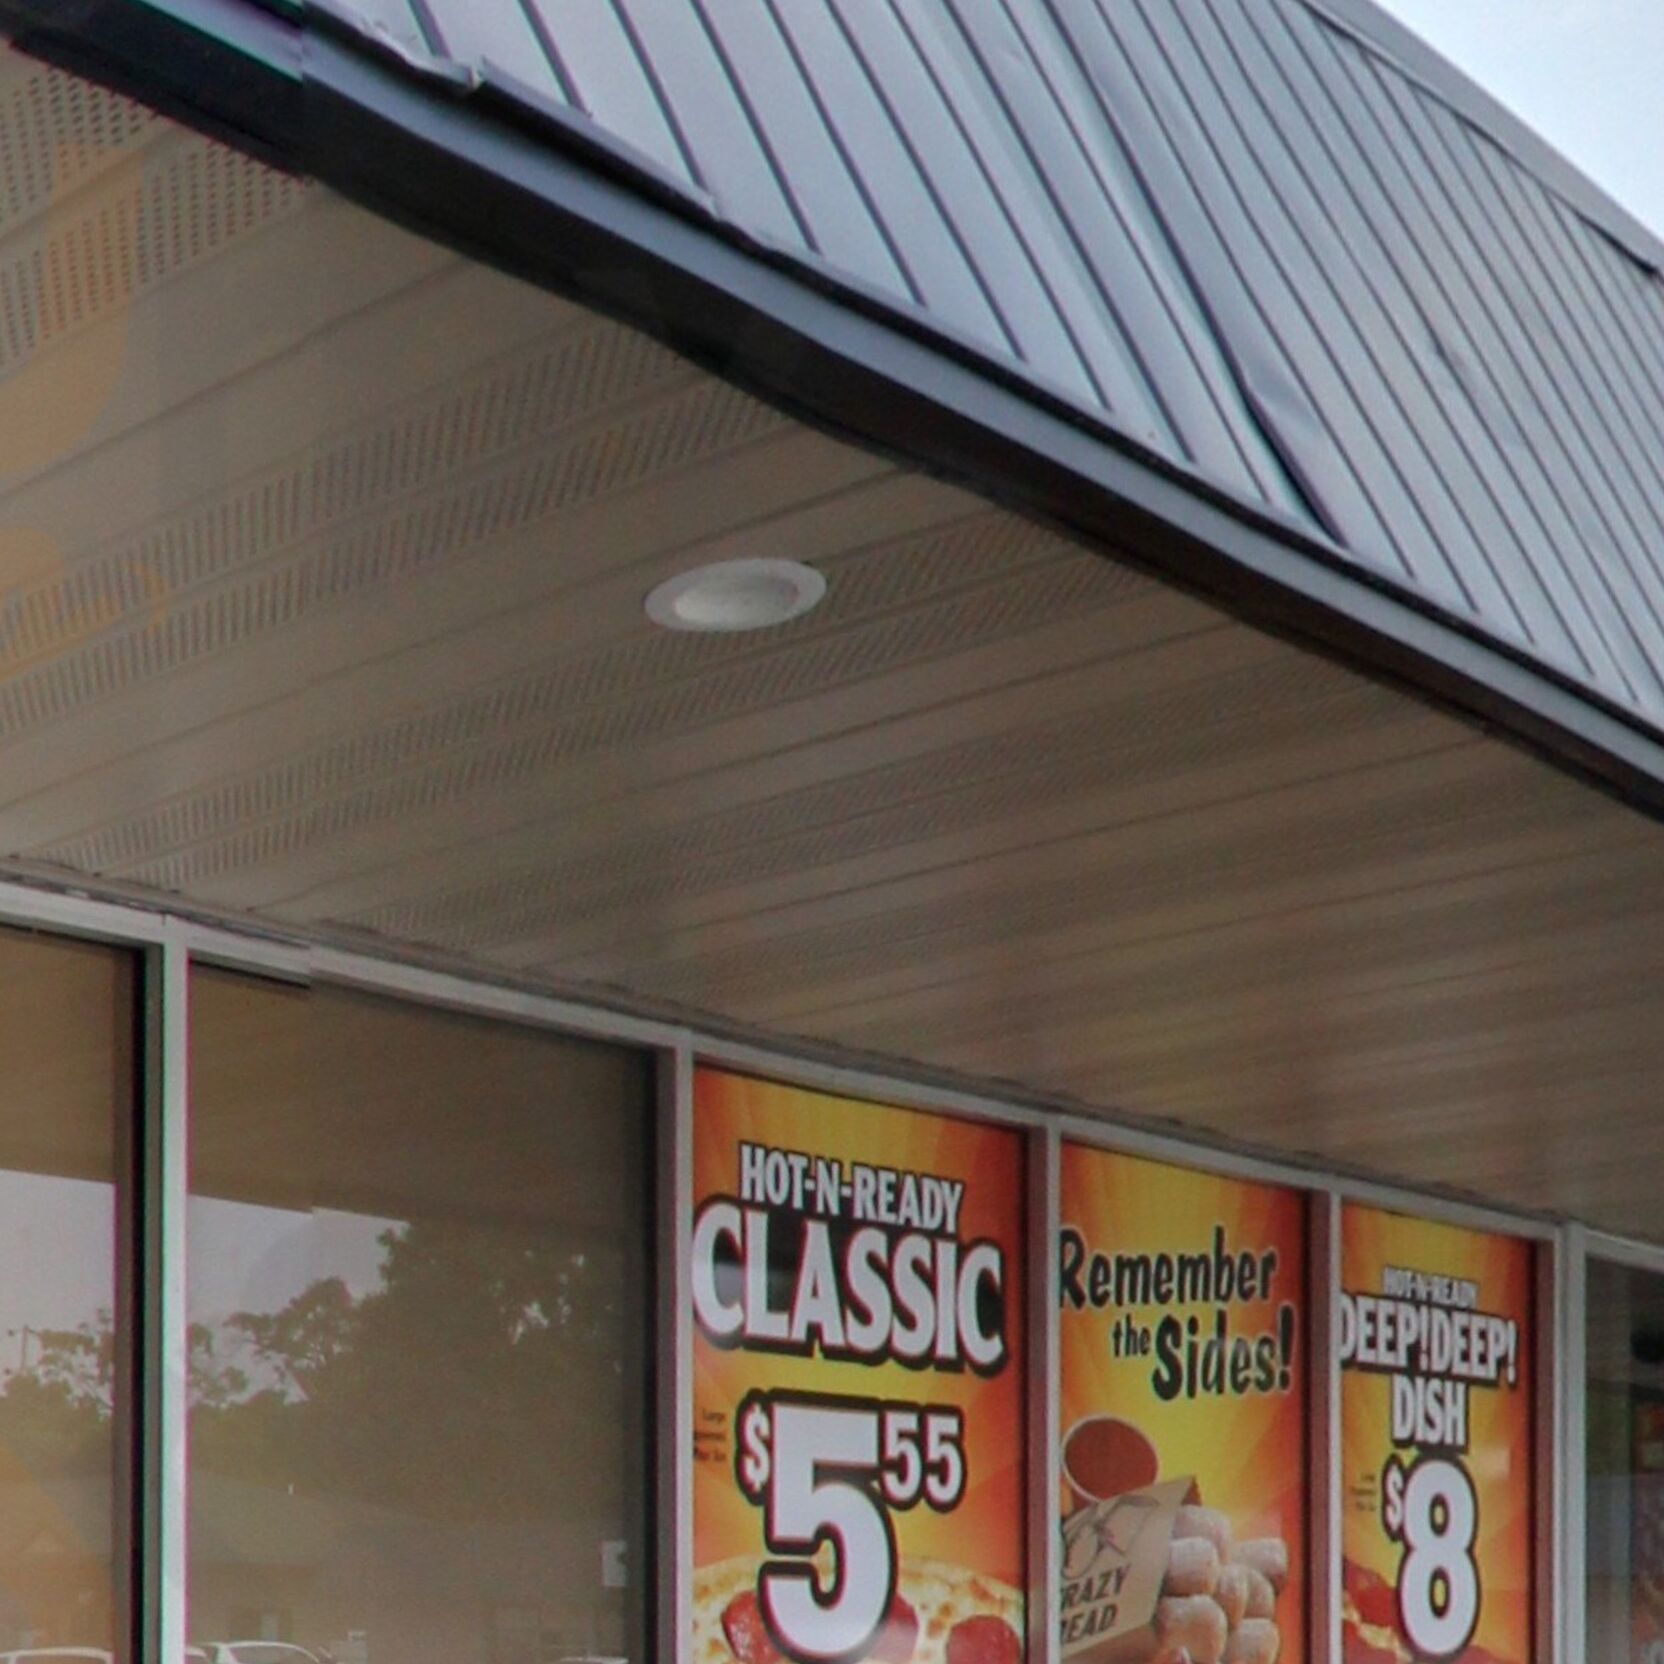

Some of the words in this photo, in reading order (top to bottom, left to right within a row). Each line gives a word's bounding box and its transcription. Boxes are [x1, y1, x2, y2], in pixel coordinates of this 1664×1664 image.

[739, 1144, 963, 1234] HOT-N-READY
[691, 1200, 1005, 1367] CLASSIC
[1059, 1224, 1278, 1310] Remember
[1113, 1312, 1151, 1358] the
[1151, 1304, 1294, 1401] Sides!
[1336, 1295, 1518, 1385] DEEP!DEEP!
[1392, 1374, 1466, 1448] DISH
[1060, 1562, 1133, 1611] RAZY
[1384, 1457, 1478, 1658] $8
